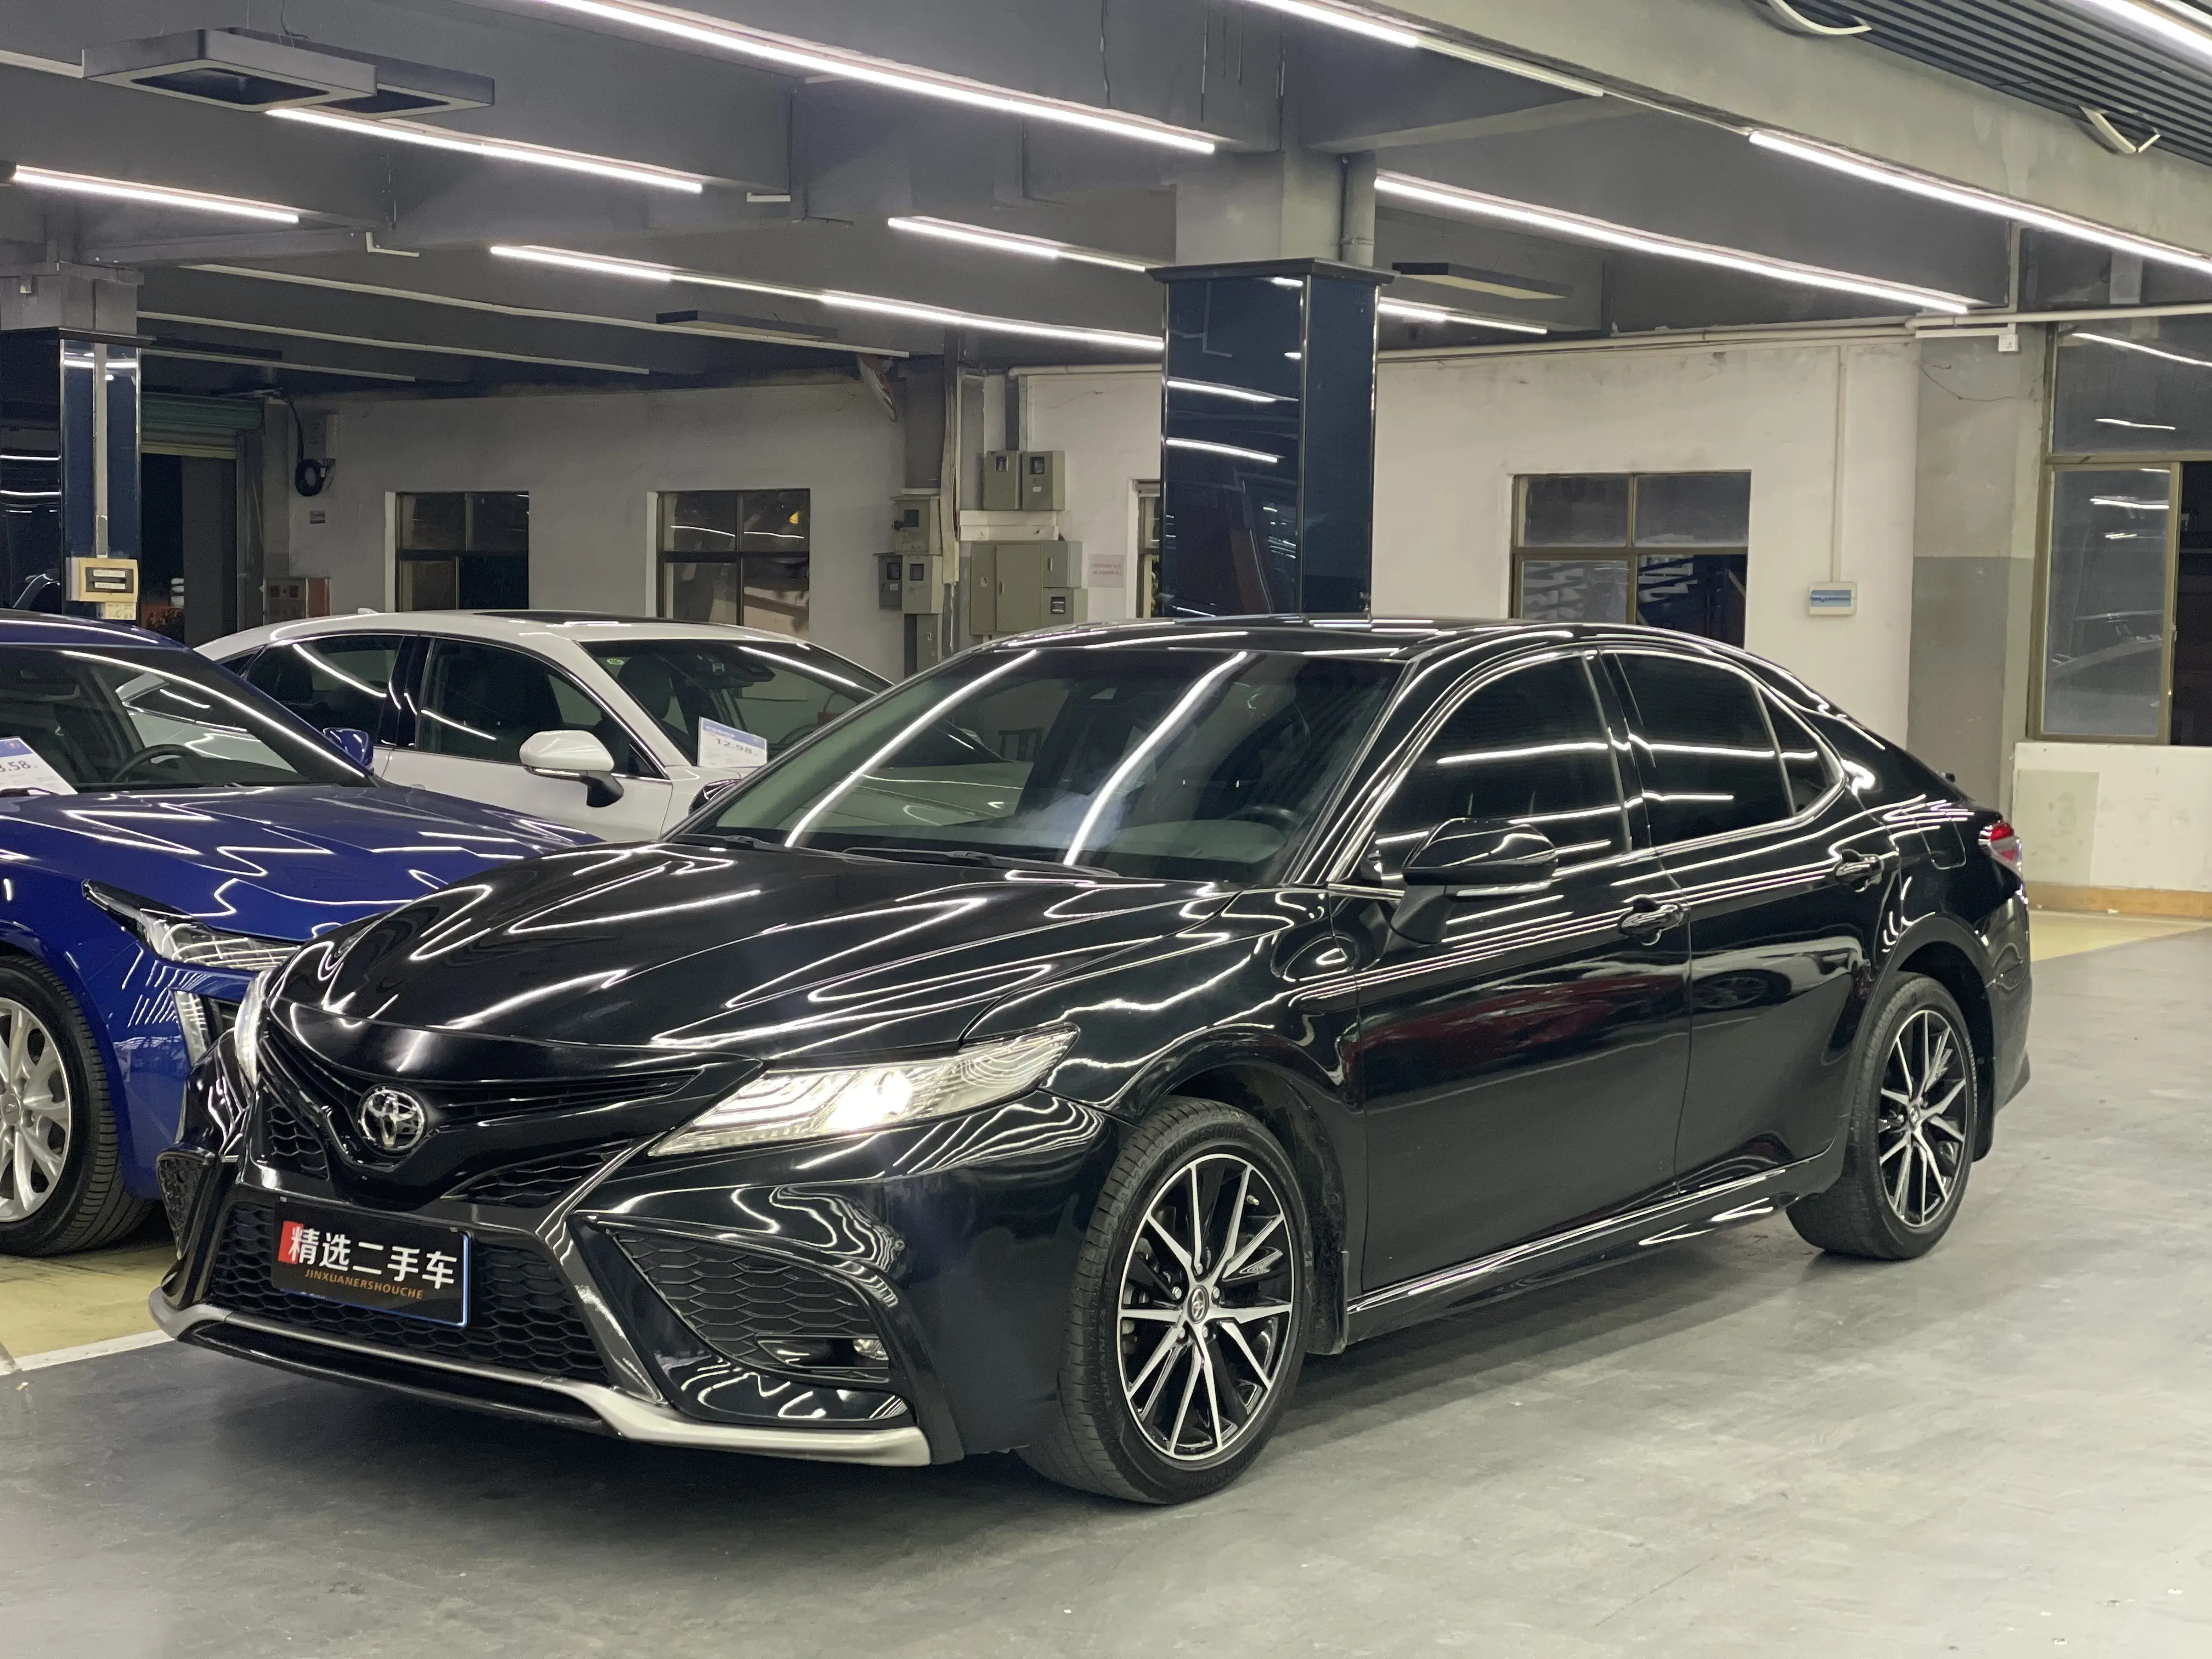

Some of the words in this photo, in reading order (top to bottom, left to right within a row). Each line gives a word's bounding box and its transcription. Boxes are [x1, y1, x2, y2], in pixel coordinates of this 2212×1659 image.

[715, 738, 753, 754] 12.98
[288, 1226, 457, 1290] 精选二手车
[304, 1268, 424, 1300] JINXUANERSHOUCHE
[1099, 1308, 1112, 1411] TURANZA
